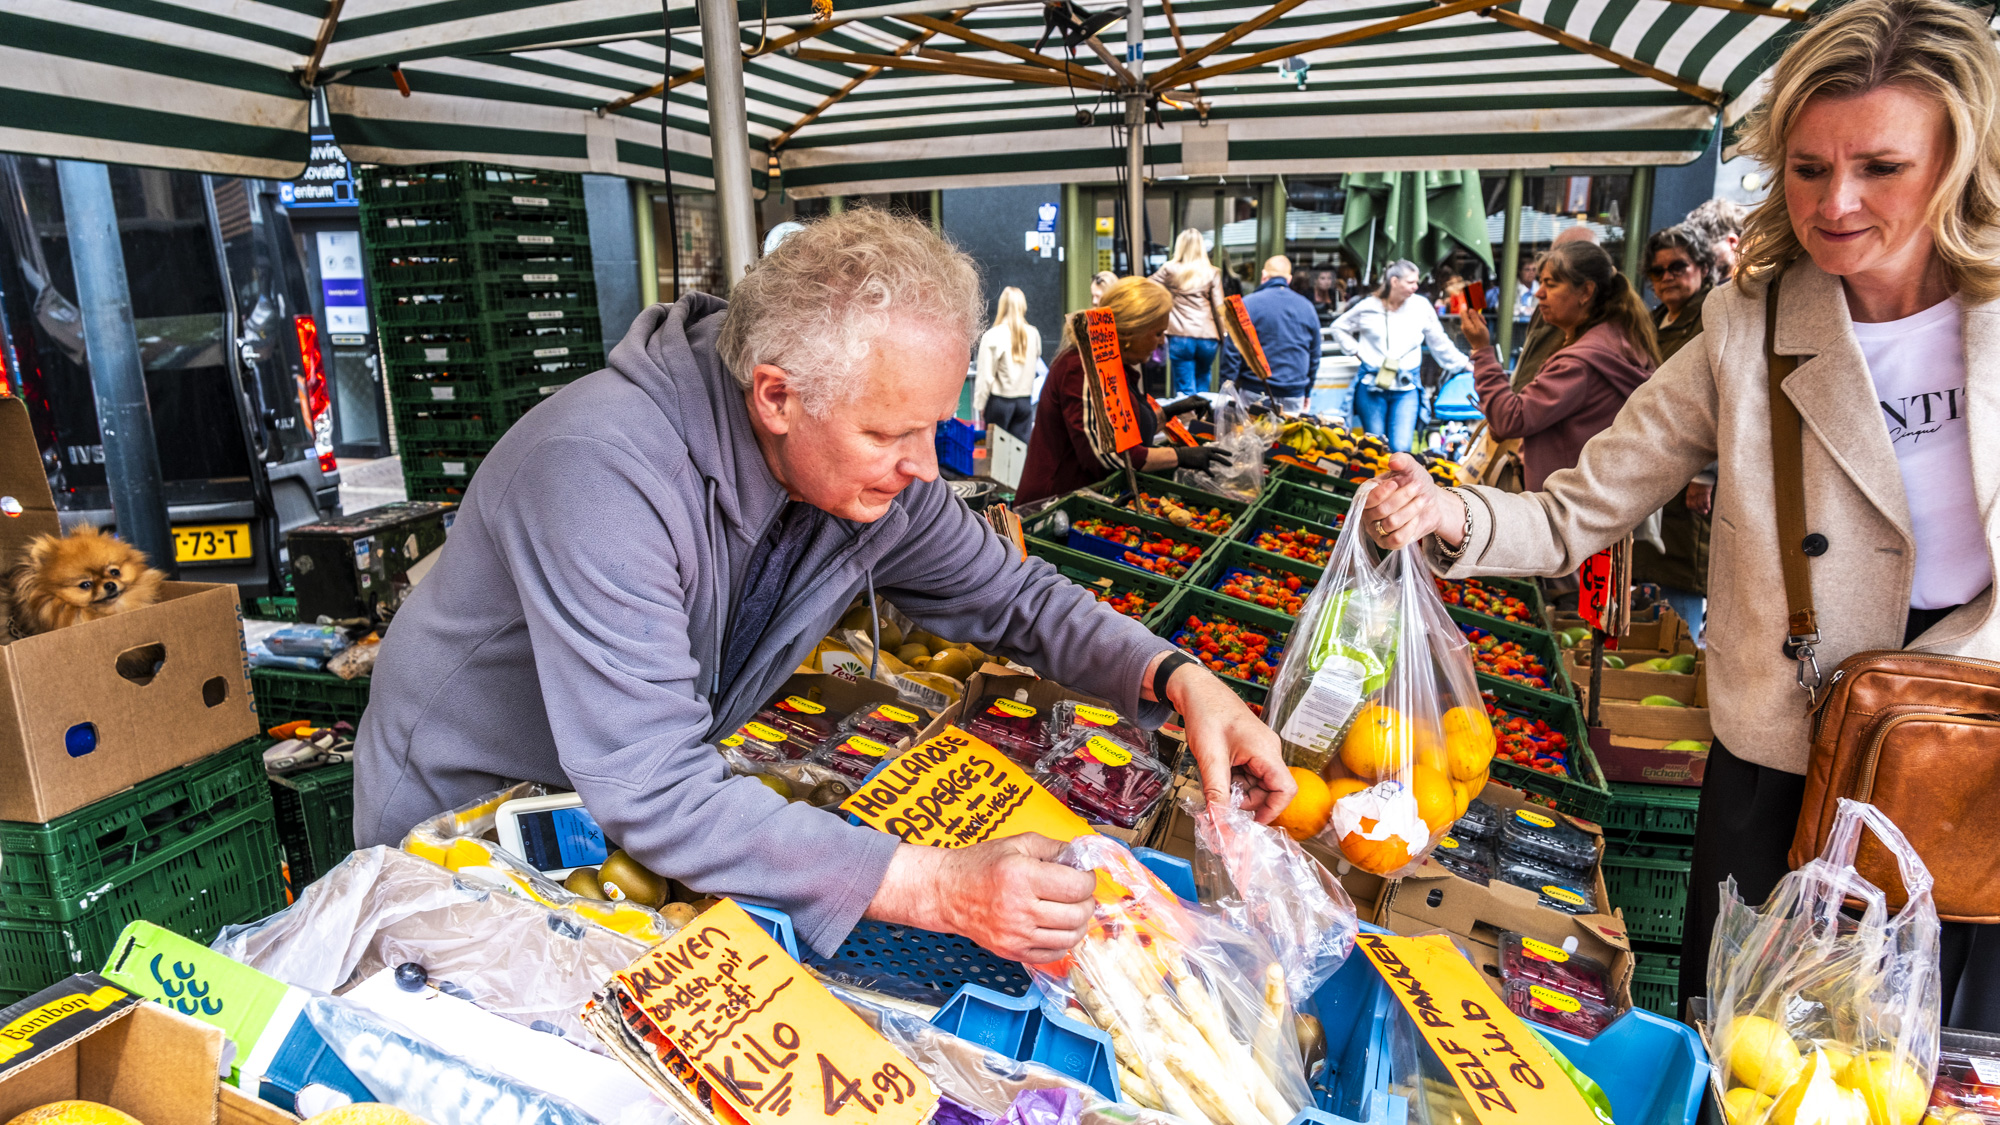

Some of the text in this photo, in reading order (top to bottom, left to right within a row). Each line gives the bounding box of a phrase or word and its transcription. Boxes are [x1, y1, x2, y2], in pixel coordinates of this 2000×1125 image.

[281, 184, 334, 201] Centrum
[1041, 234, 1051, 246] 12
[1880, 386, 1966, 429] NTI
[996, 699, 1035, 715] Driscoll's
[1076, 706, 1117, 721] Driscoll's
[1090, 738, 1128, 763] Driscoll's
[1357, 933, 1518, 1114] ZELF PAKKEN
[816, 1053, 916, 1116] 4.99
